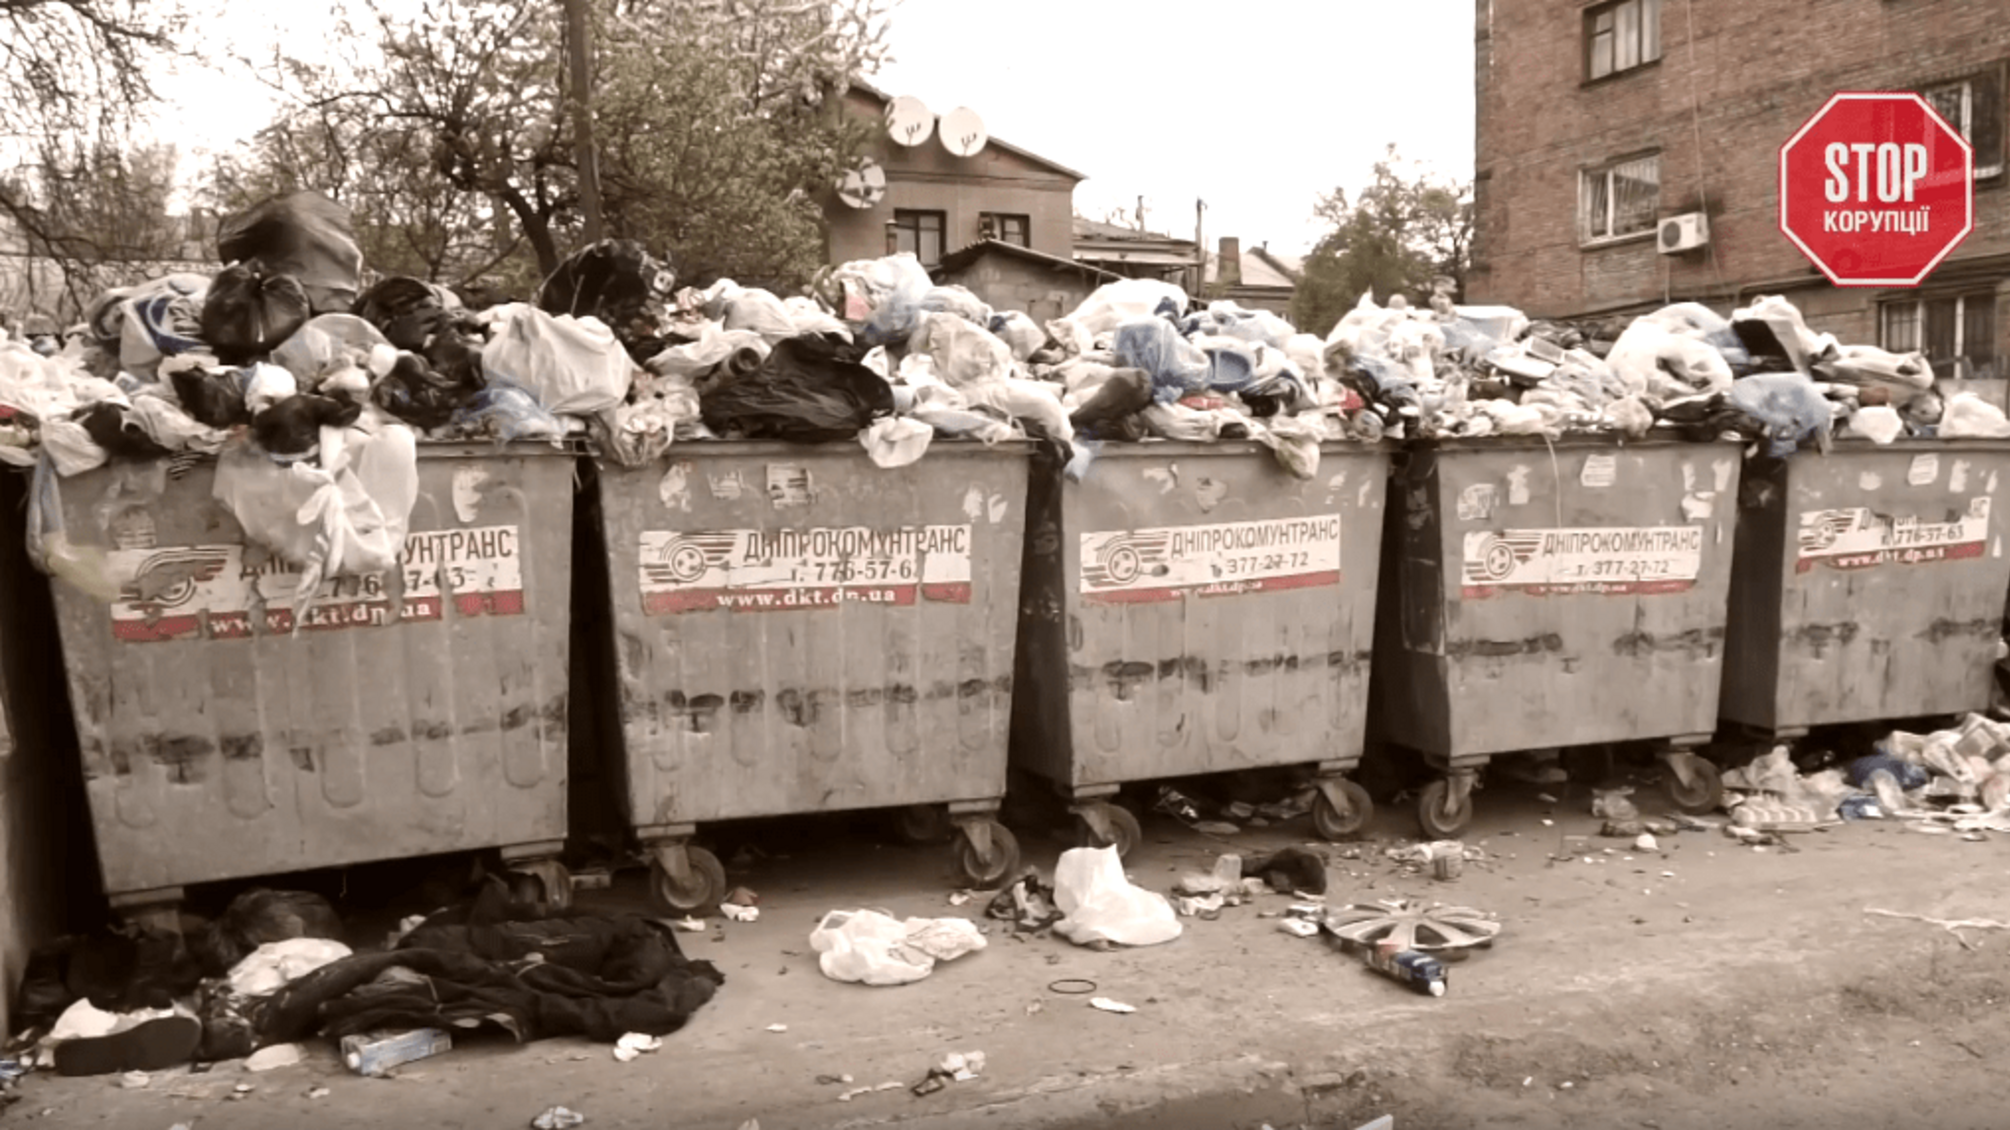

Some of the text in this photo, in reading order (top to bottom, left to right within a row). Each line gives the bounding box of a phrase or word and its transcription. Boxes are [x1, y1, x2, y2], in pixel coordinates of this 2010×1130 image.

[744, 527, 966, 563] ДНІПРОКОМУНТРАНС
[1170, 519, 1339, 559] ДНІПРОКОМУНТРАНС
[1542, 531, 1700, 556] ДНІПРОКОМУНТРАНС
[1226, 551, 1309, 574] 377-27-72
